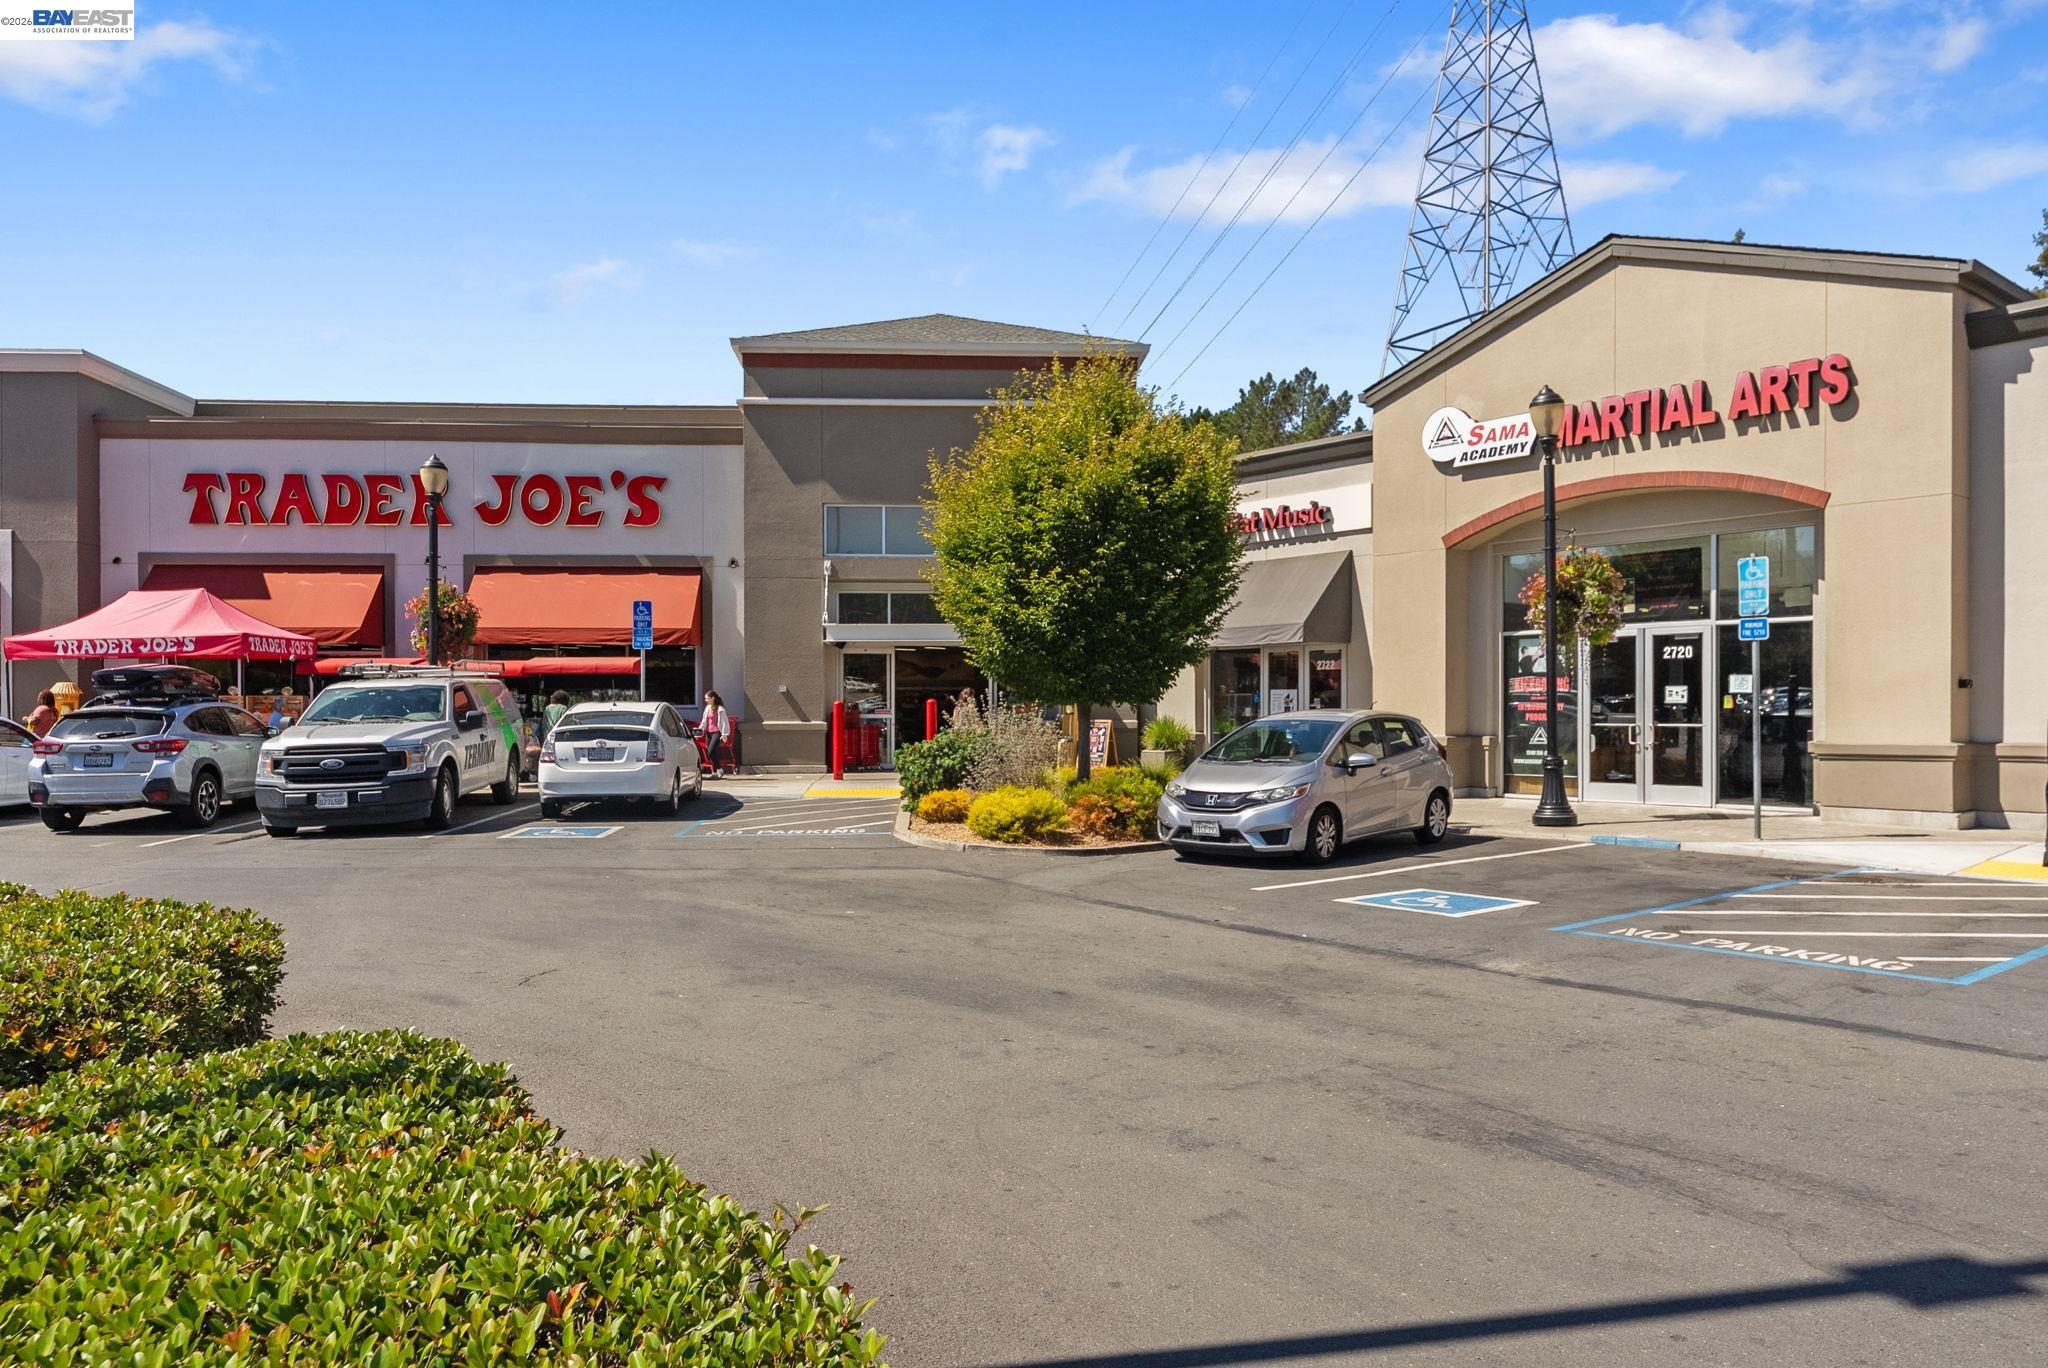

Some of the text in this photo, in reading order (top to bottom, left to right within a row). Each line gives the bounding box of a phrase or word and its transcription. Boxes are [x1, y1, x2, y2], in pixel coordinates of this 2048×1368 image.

[1728, 353, 1850, 420] ARTS
[1468, 421, 1529, 446] SAMA
[1460, 441, 1529, 462] ACADEMY
[473, 469, 668, 527] JOE'S
[1261, 501, 1331, 531] Music
[1744, 589, 1763, 599] ONLY
[54, 636, 196, 656] TRADER JOE'S
[248, 637, 314, 656] TRADER JOE'S
[1663, 645, 1693, 659] 2720
[1317, 660, 1336, 670] 2722
[757, 828, 866, 836] PARKING
[1609, 927, 1914, 971] NO PARKING
